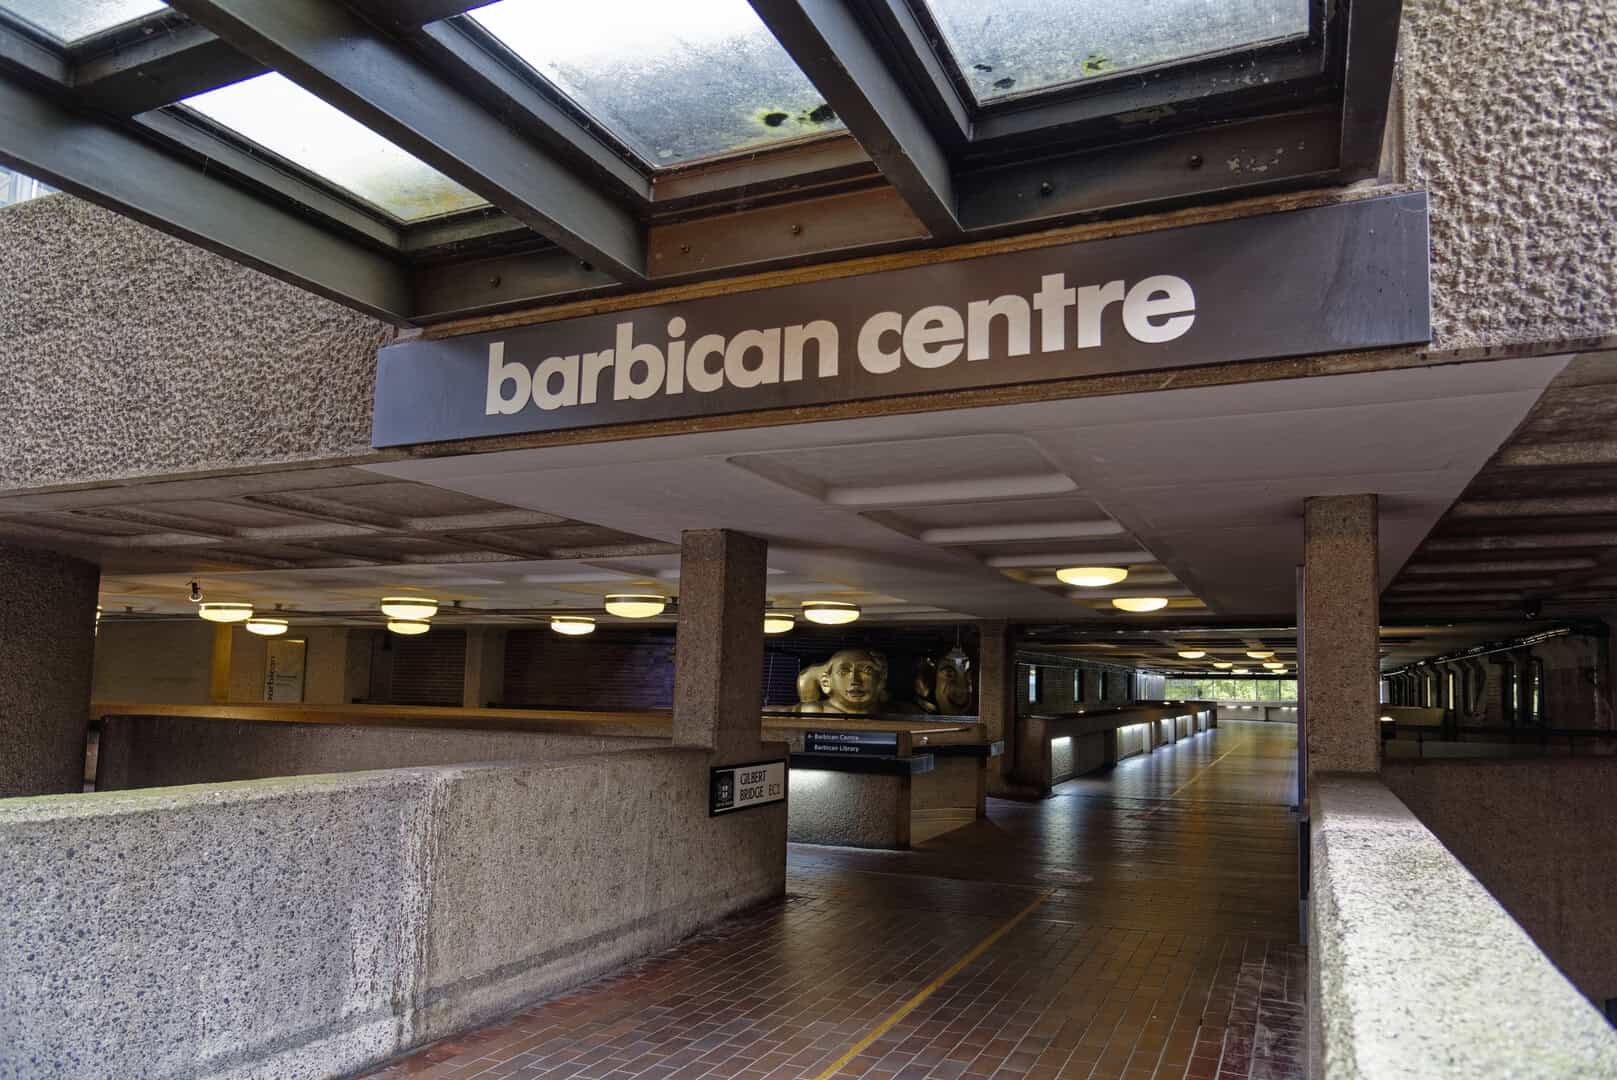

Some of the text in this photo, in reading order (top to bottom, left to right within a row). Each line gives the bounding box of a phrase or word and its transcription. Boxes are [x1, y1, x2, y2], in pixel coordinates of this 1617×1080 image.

[485, 273, 1197, 416] barbican centre
[840, 744, 860, 753] Library
[740, 770, 767, 784] GILBERT
[740, 785, 764, 800] BRIDGE
